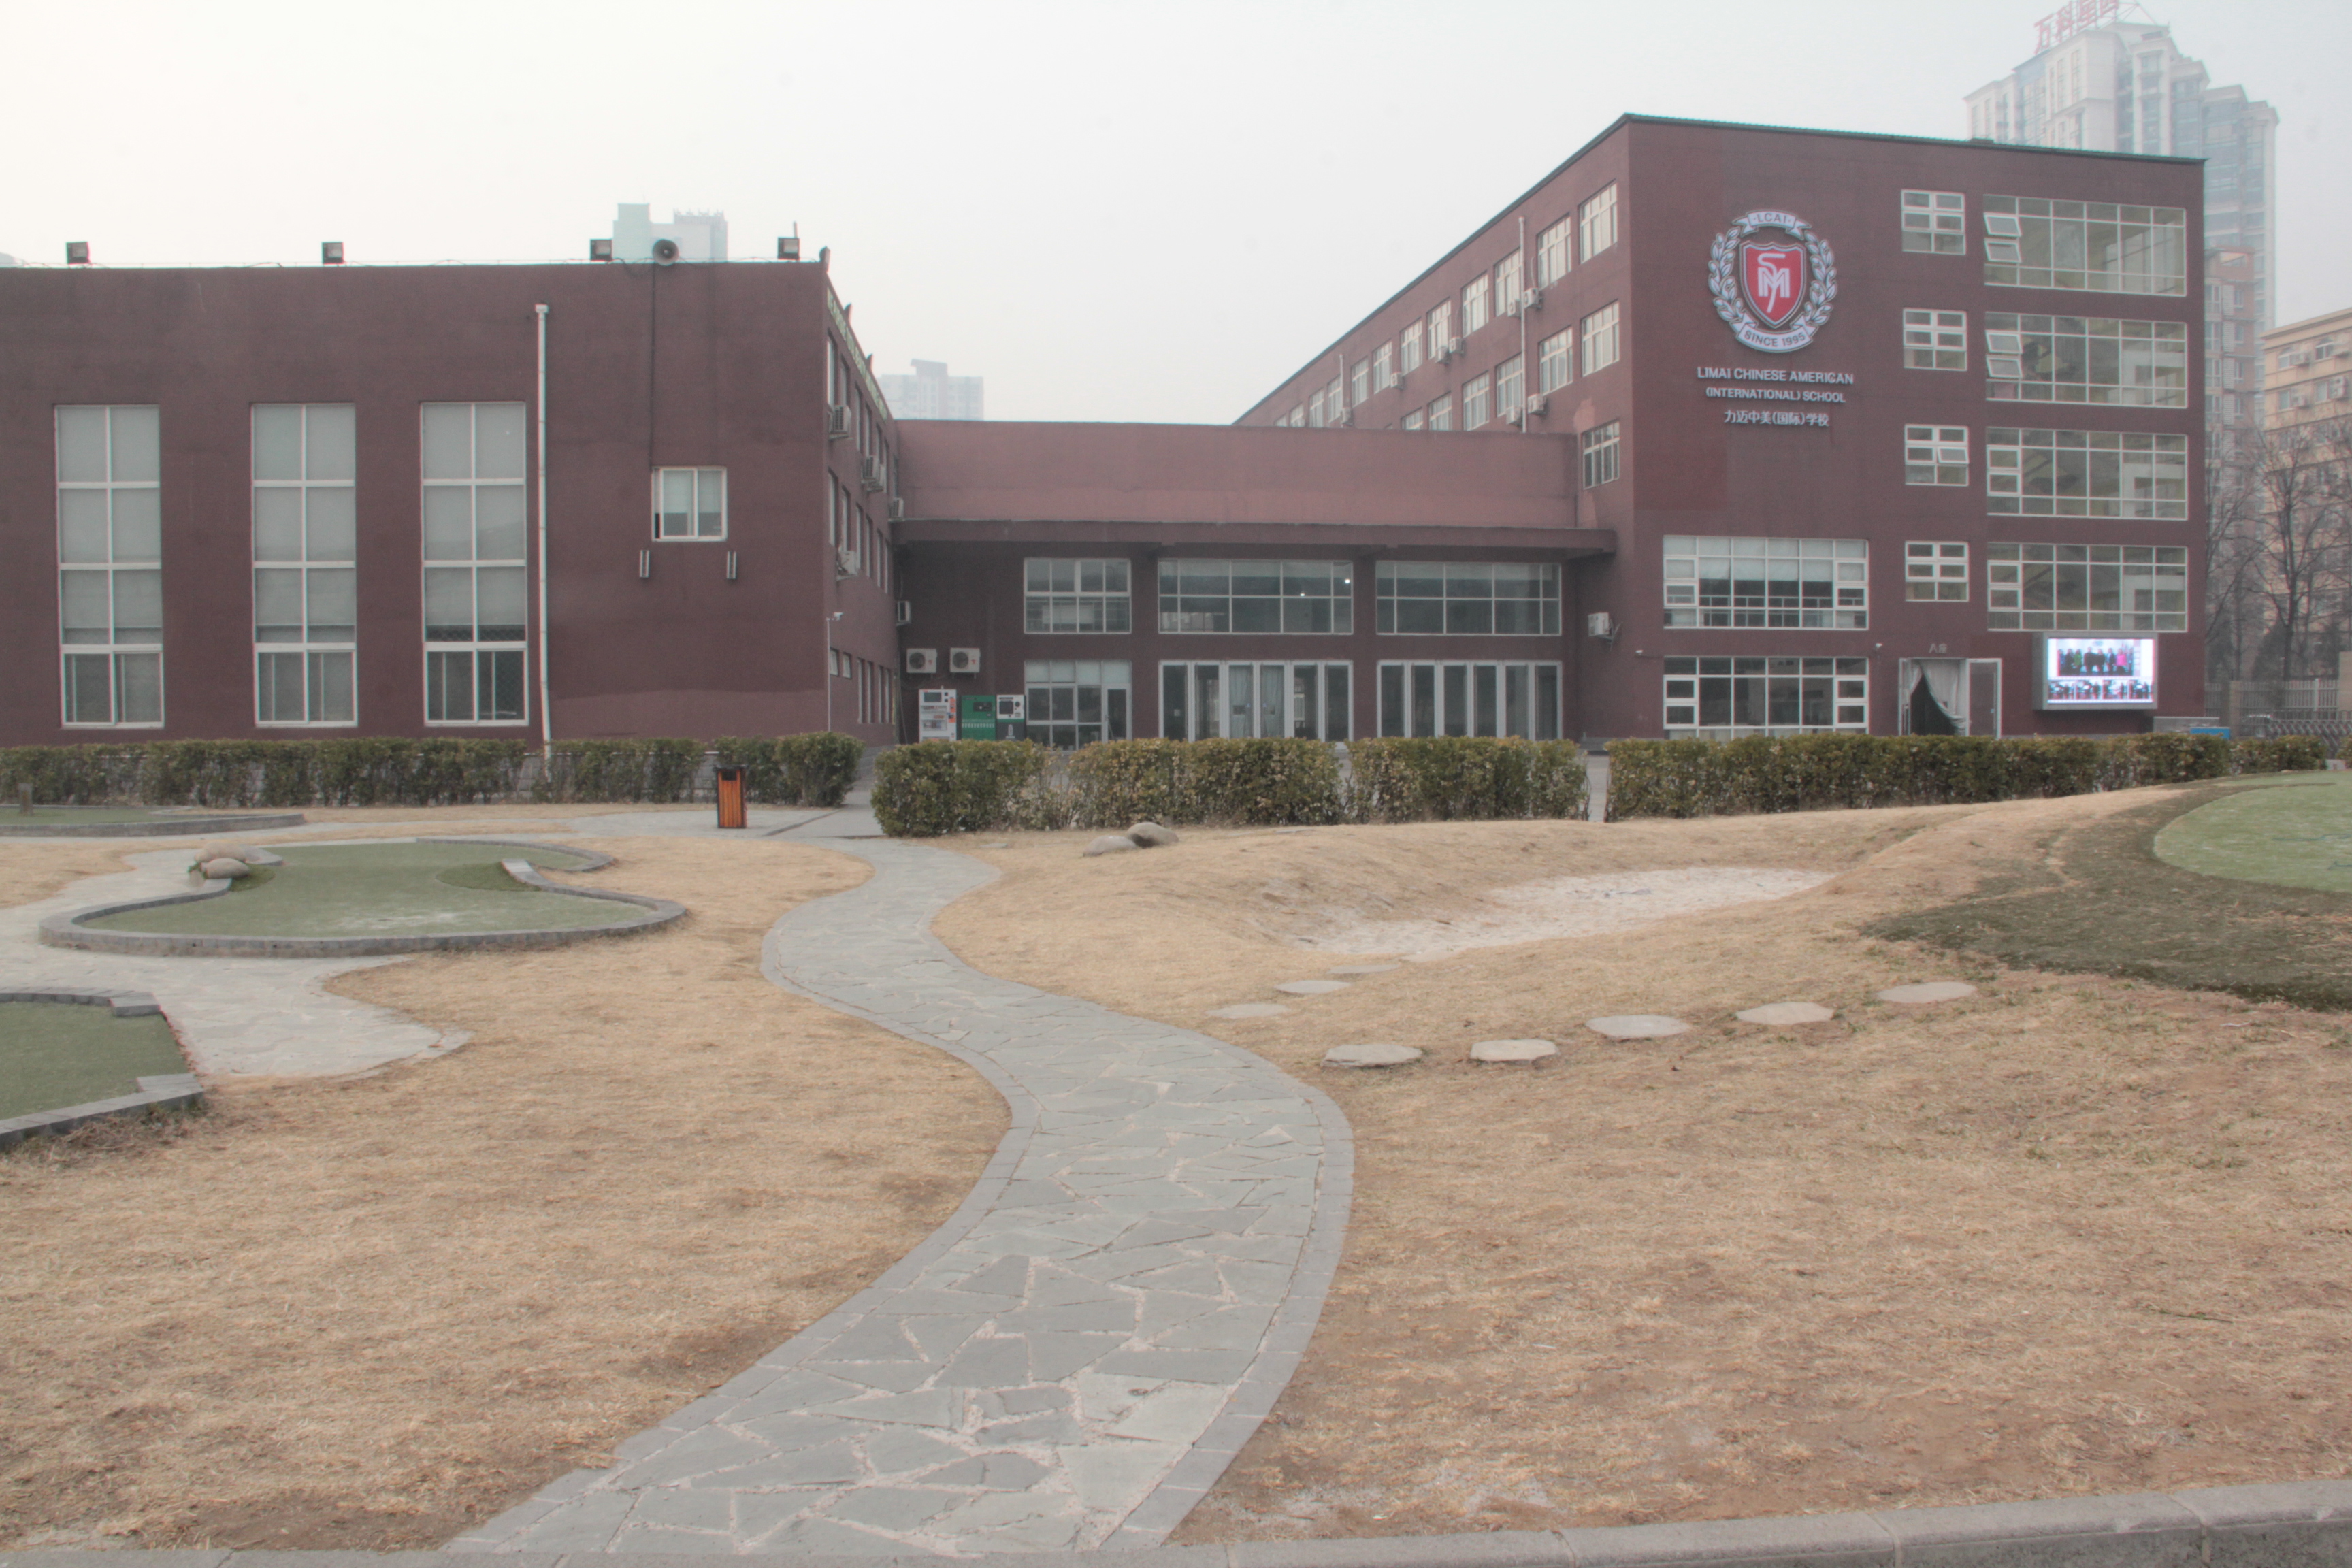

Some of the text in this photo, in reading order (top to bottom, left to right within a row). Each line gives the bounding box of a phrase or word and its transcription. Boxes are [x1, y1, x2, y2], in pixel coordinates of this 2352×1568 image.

[1757, 213, 1787, 223] LCAI
[1744, 331, 1806, 347] SINCE 1995
[1697, 368, 1854, 384] LIMAI CHINESE AMERICAN
[1706, 387, 1846, 403] (INTERNATIONAL) SCHOOL
